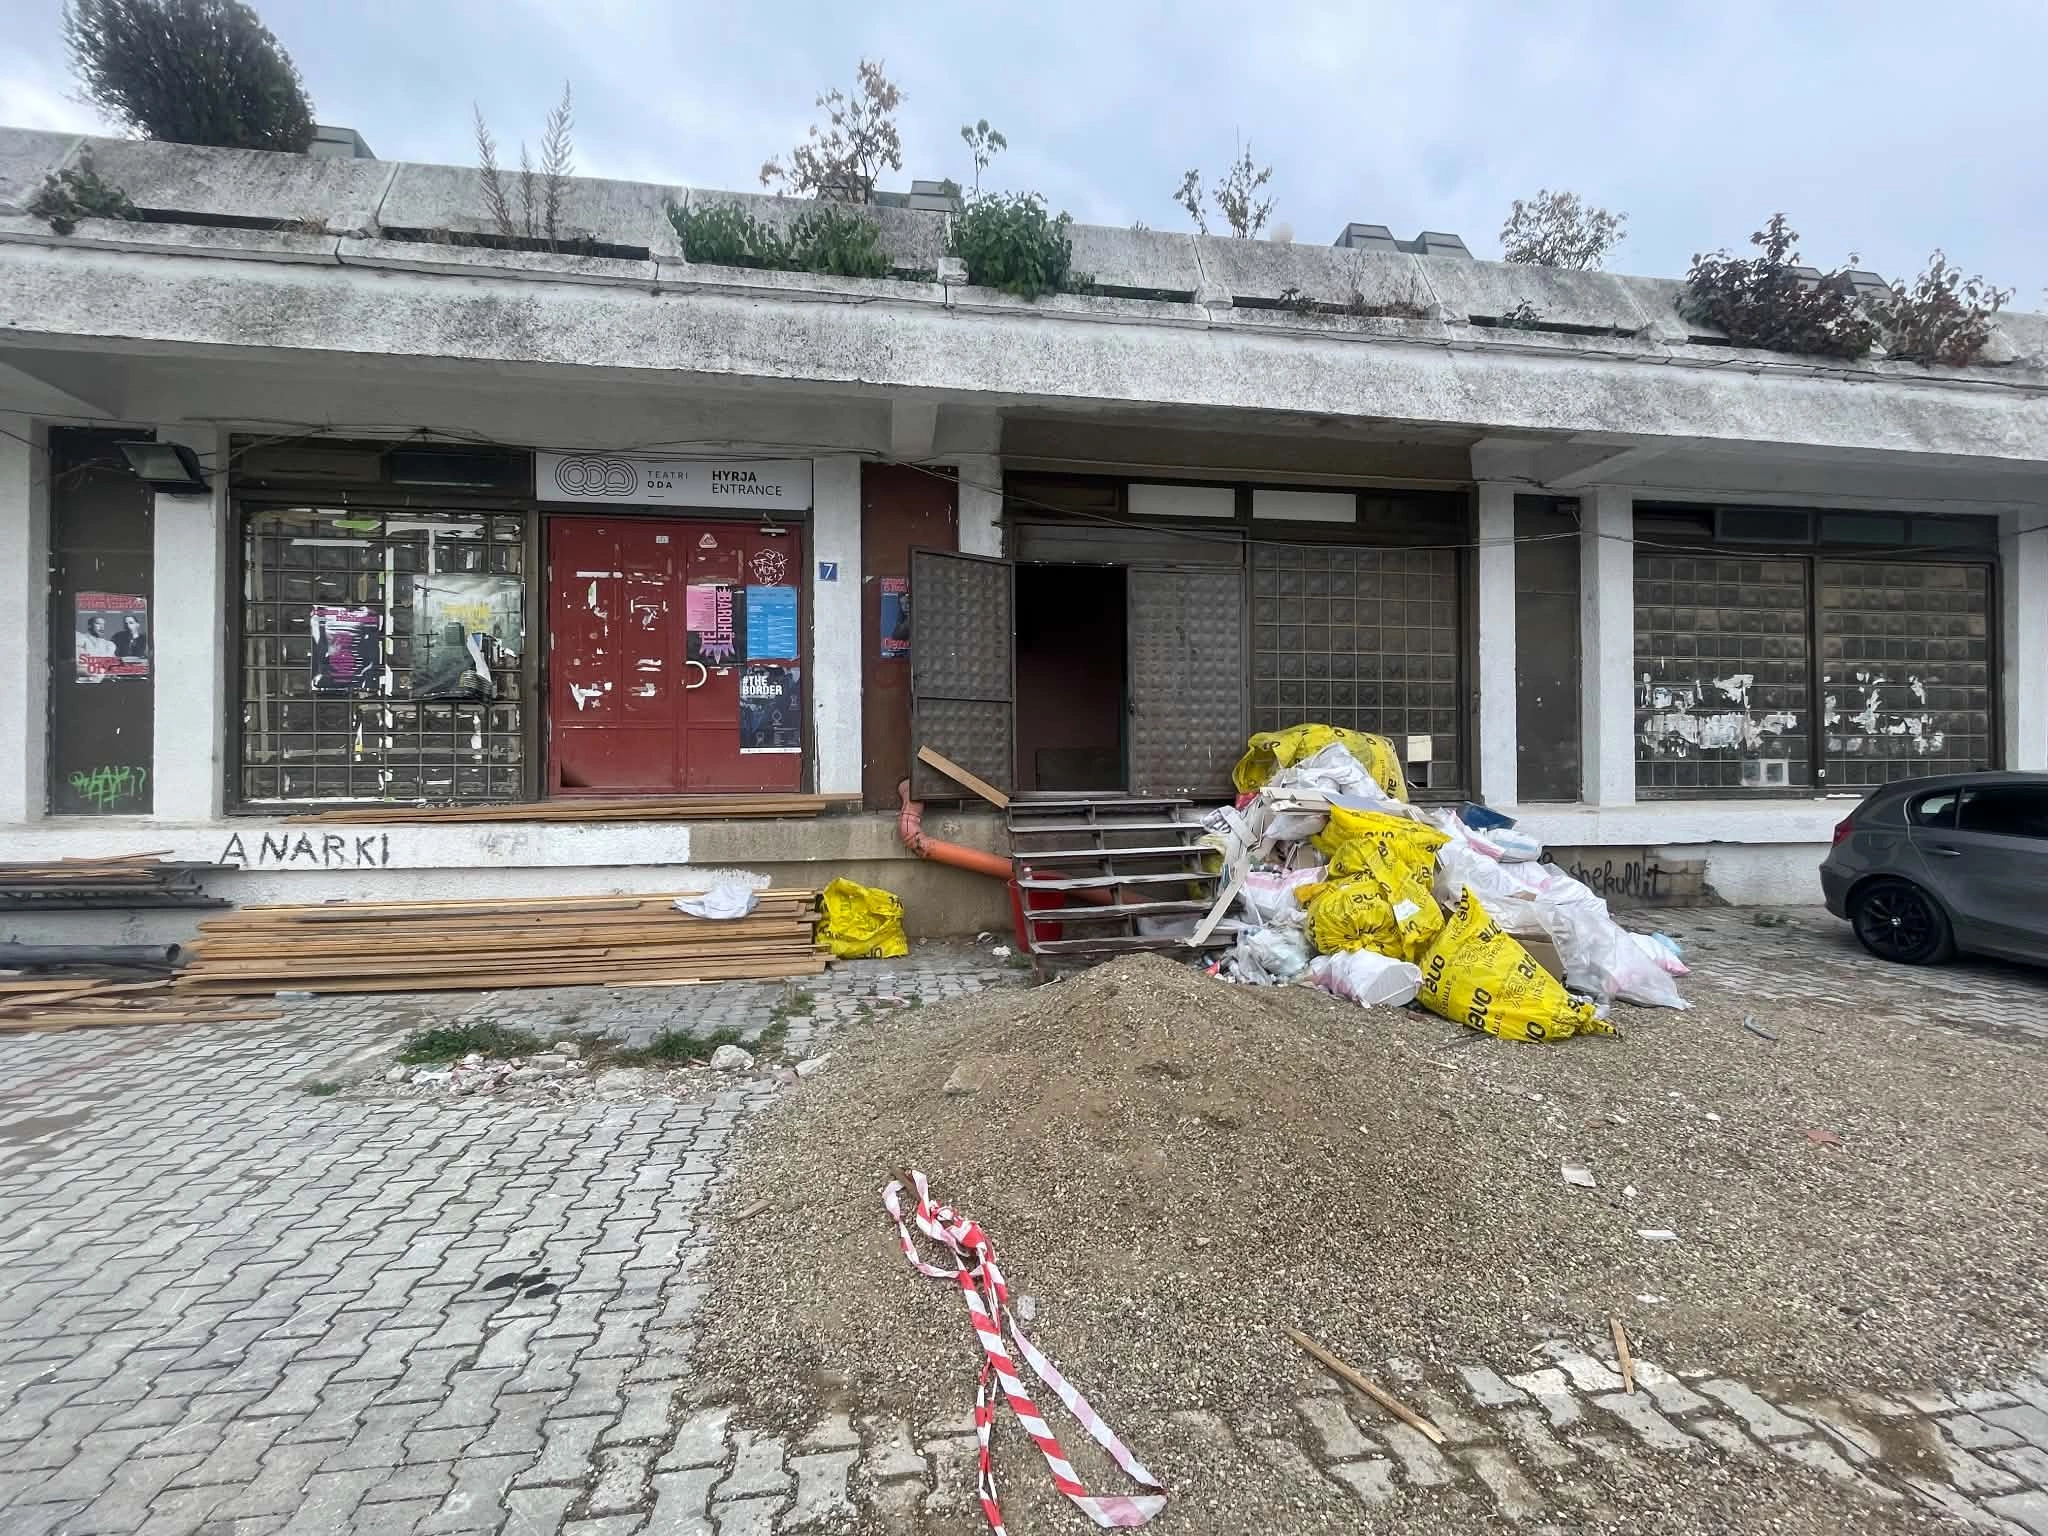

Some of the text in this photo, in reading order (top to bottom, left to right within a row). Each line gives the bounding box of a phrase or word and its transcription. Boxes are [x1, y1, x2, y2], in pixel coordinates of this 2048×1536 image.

[647, 470, 688, 480] TEATRI
[712, 470, 757, 482] HYRJA
[647, 480, 673, 489] ODA
[712, 483, 783, 496] ENTRANCE
[823, 563, 833, 580] 7
[742, 675, 768, 686] #THE
[219, 831, 390, 867] ANARKI
[1424, 954, 1446, 994] one
[1467, 987, 1492, 1030] one
